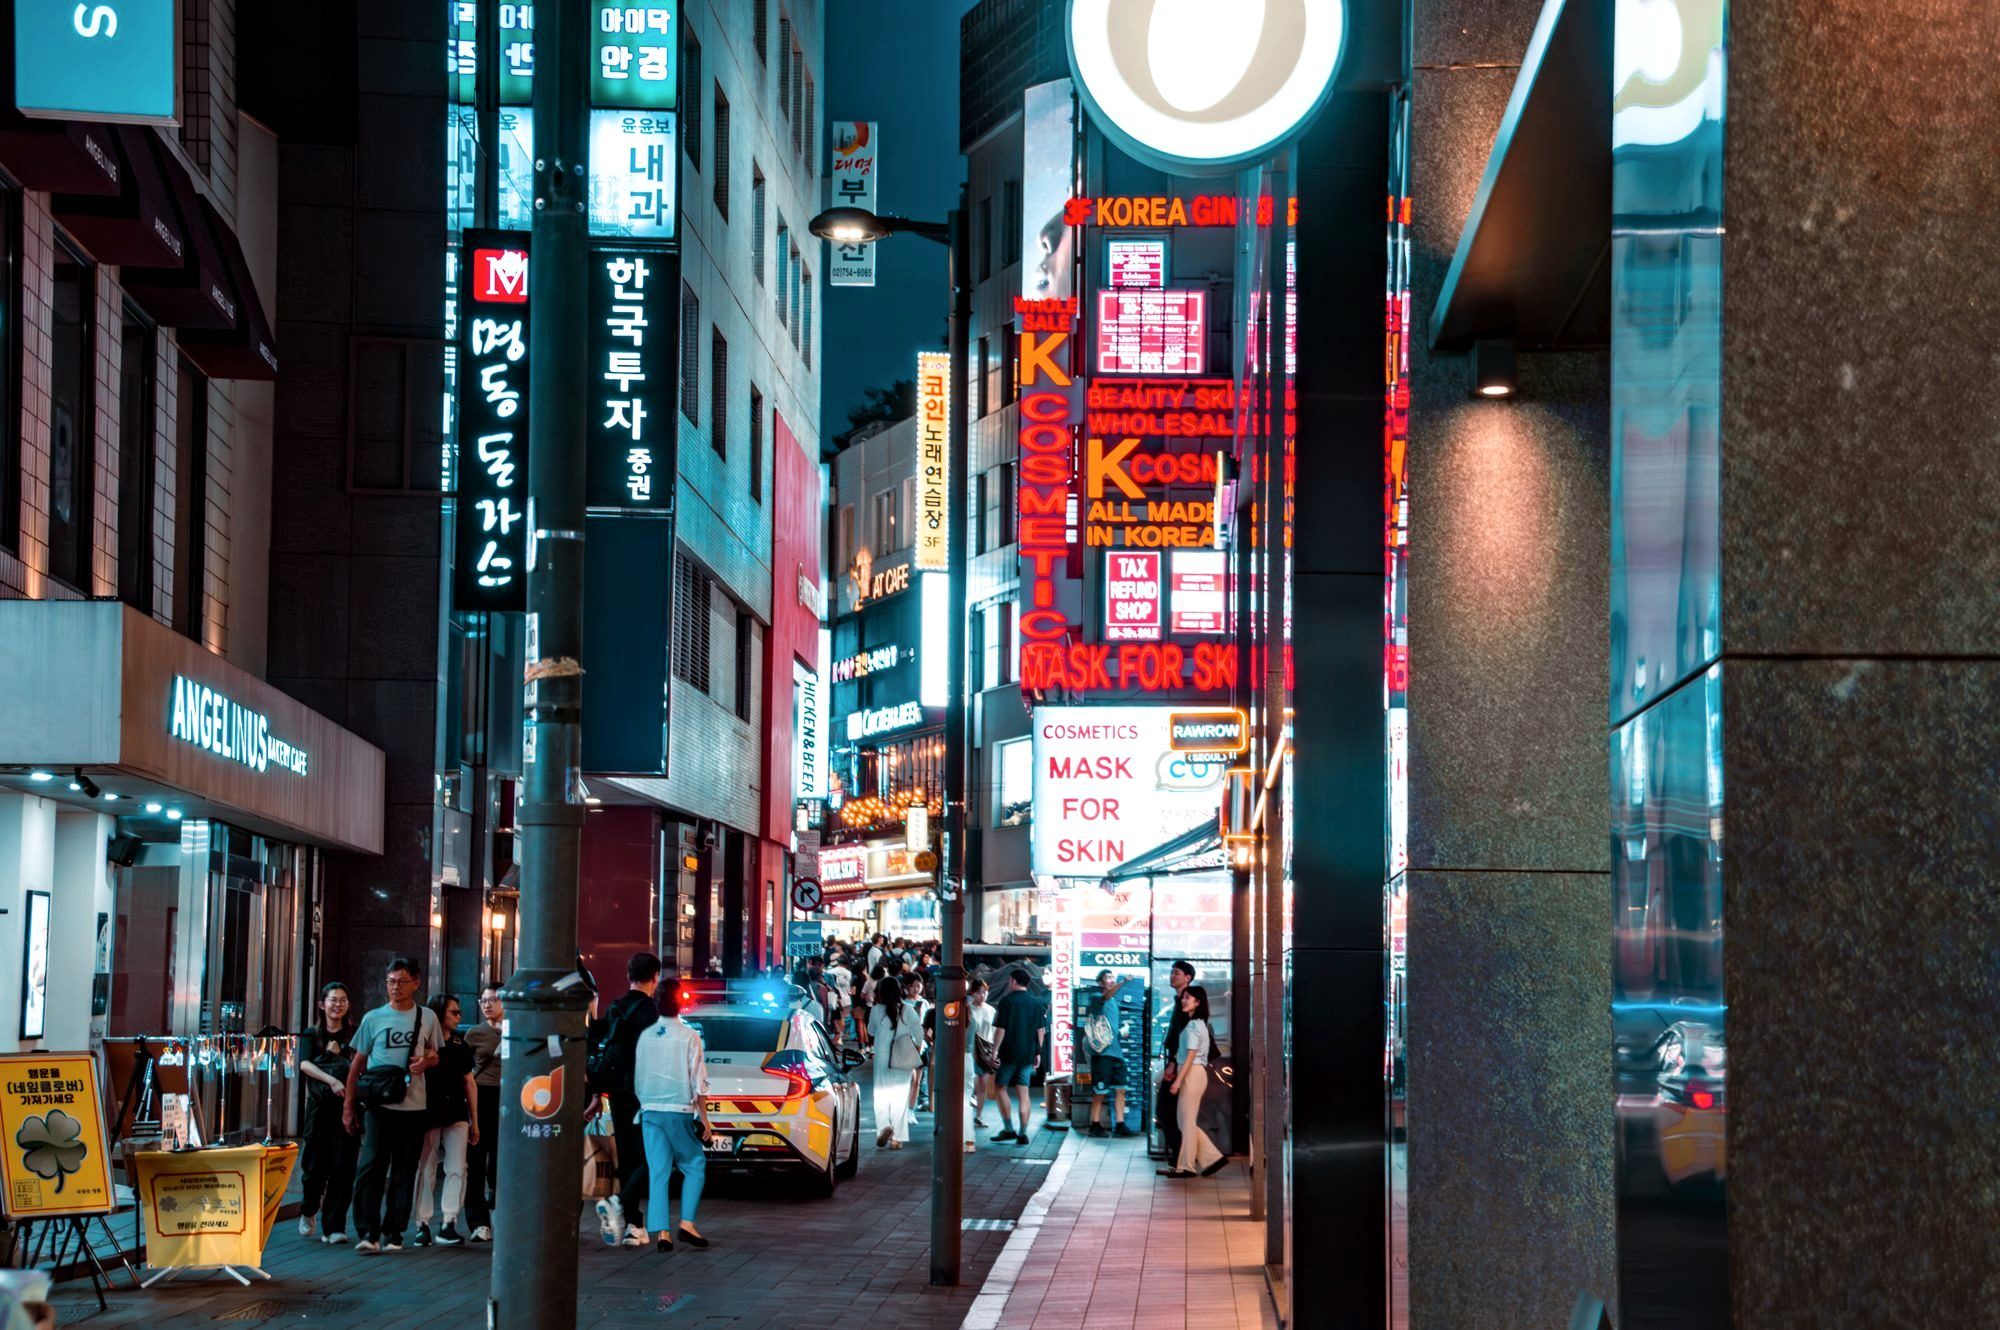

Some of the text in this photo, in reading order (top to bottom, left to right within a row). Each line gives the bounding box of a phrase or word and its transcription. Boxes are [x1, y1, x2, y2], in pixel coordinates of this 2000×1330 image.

[601, 8, 671, 34] 아이닥
[601, 45, 668, 81] 안경
[627, 144, 668, 226] 내과
[838, 179, 867, 262] 부산
[1097, 197, 1187, 226] KOREA
[1014, 296, 1079, 314] WHOLE
[1023, 313, 1072, 332] SALE
[603, 257, 650, 440] 한국투자
[1020, 332, 1072, 386] K
[1088, 387, 1235, 410] BEAUTY SKI
[1088, 412, 1235, 437] WHOLESAL
[626, 448, 653, 500] 증권
[1087, 438, 1146, 499] K
[1088, 501, 1138, 522] ALL
[924, 536, 940, 548] 3F
[1087, 526, 1216, 547] IN KOREA
[885, 563, 909, 595] CAFE
[1117, 557, 1148, 578] TAX
[1109, 580, 1158, 600] REFUND
[1115, 601, 1152, 620] SHOP
[1021, 643, 1238, 691] MASK FOR SK
[172, 675, 268, 773] ANGELINUS
[290, 747, 308, 776] CAFE
[1043, 725, 1138, 740] COSMETICS
[1173, 724, 1240, 738] RAWROW
[1049, 756, 1133, 779] MASK
[1062, 798, 1120, 821] FOR
[1057, 839, 1125, 862] SKIN
[1095, 953, 1140, 965] COSRX
[1055, 941, 1070, 1047] COSMETICS
[385, 1028, 415, 1049] Lee
[520, 1124, 562, 1138] 서울중구
